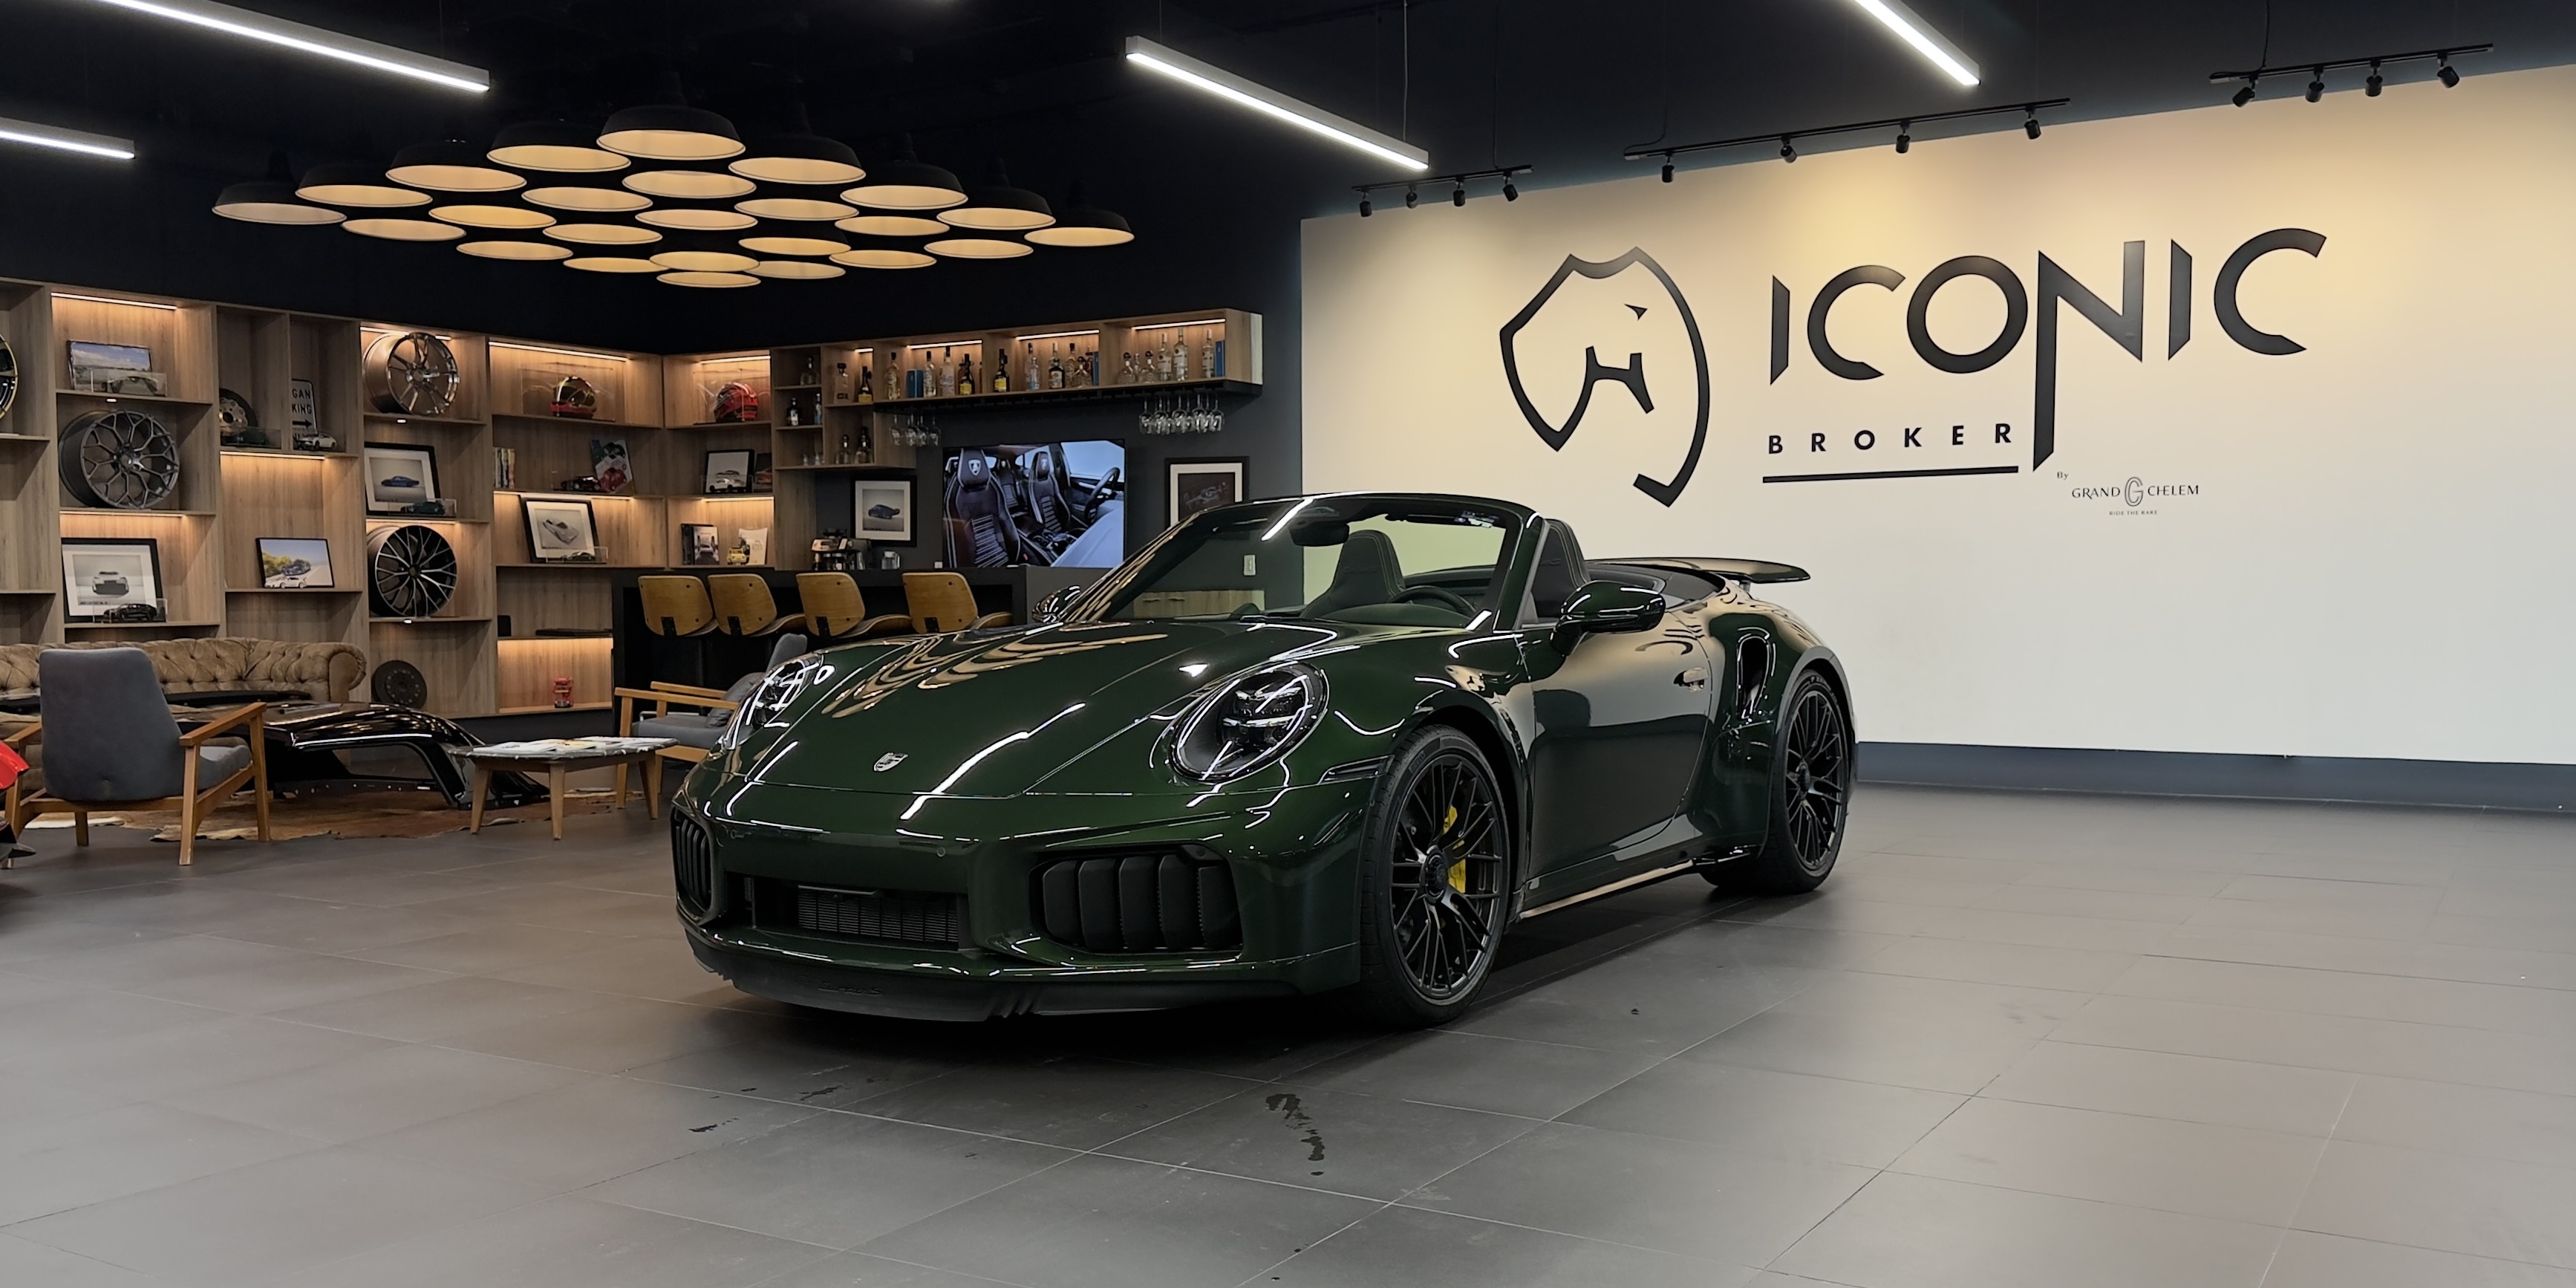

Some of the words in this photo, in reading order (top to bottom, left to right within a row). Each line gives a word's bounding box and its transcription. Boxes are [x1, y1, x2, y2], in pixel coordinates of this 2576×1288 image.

[1770, 227, 2327, 472] ICONIC
[1767, 422, 2012, 455] BROKER
[2056, 471, 2069, 481] By
[2071, 487, 2121, 500] GRAND
[2147, 484, 2199, 496] CHELEM
